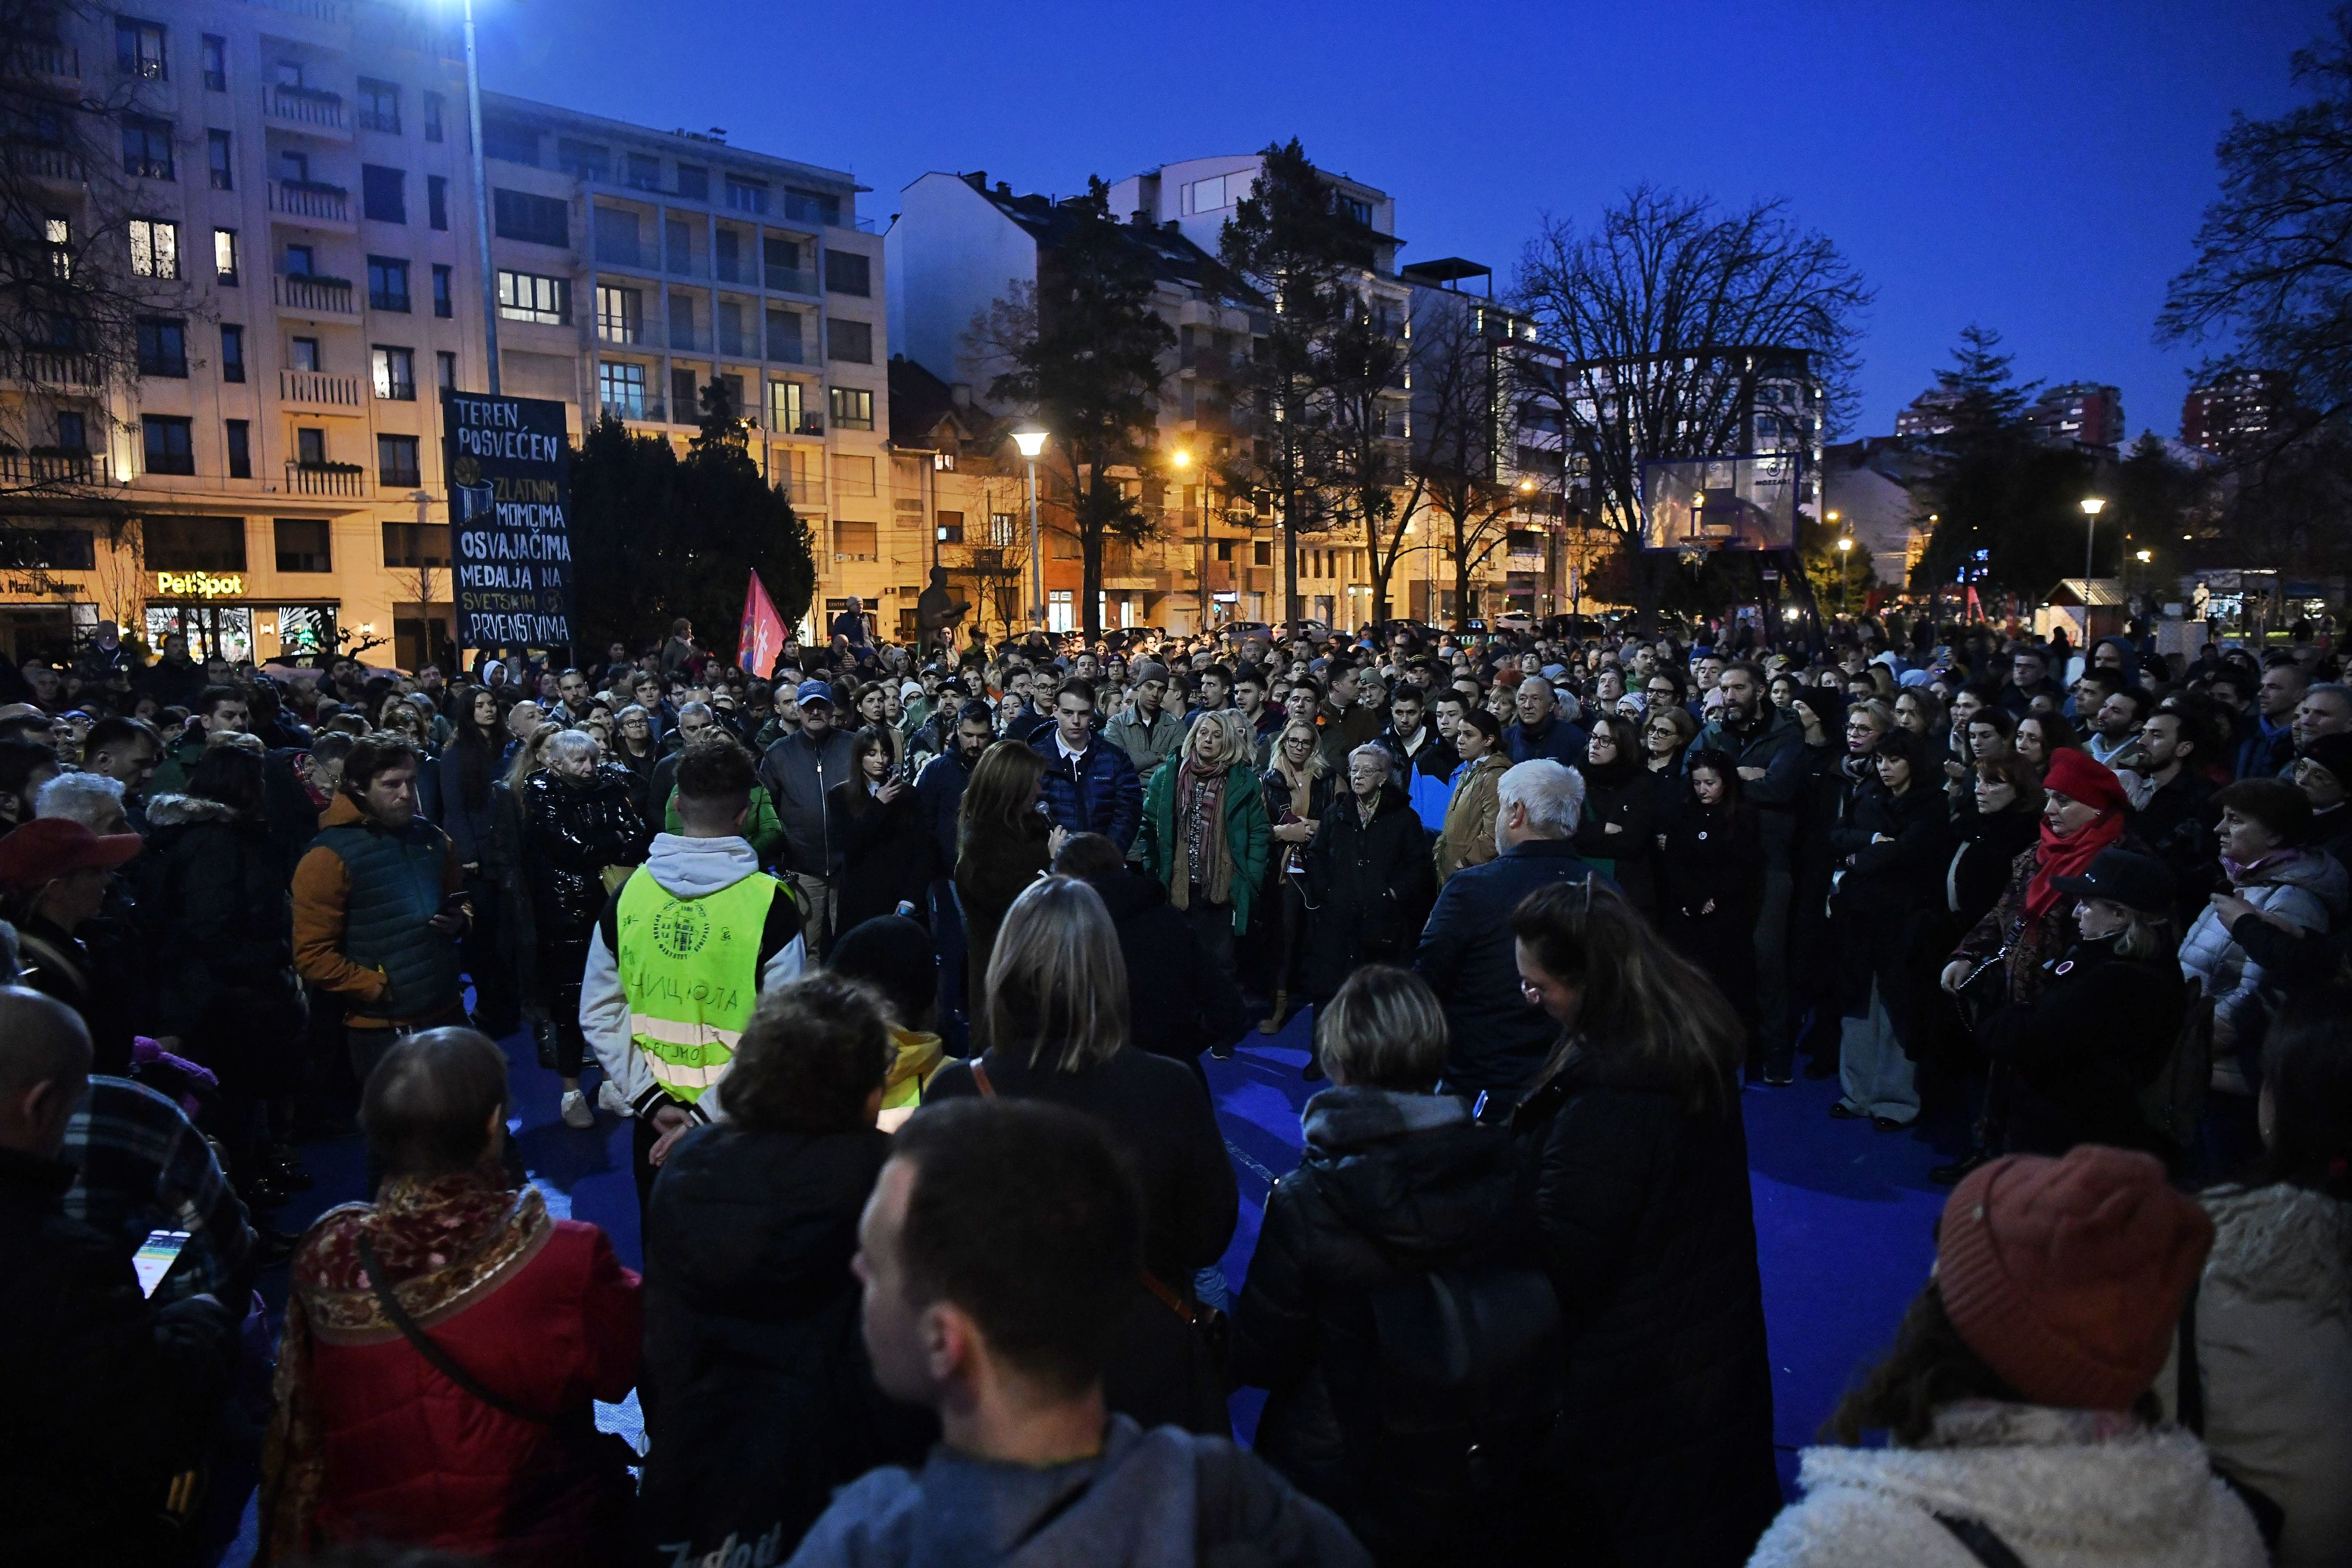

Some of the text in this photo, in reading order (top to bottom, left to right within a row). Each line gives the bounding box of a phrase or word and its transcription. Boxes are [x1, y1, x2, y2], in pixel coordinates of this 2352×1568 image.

[453, 399, 517, 428] TEREN
[458, 425, 557, 463] POSVEĆEN
[494, 477, 559, 503] ZLATNIM
[496, 503, 565, 528] MOMCIMA
[462, 528, 571, 562] OSVAJAČIMA
[542, 567, 562, 587] NA
[462, 591, 536, 610] SVETSKIM
[470, 611, 569, 644] PRVENSTVIMA
